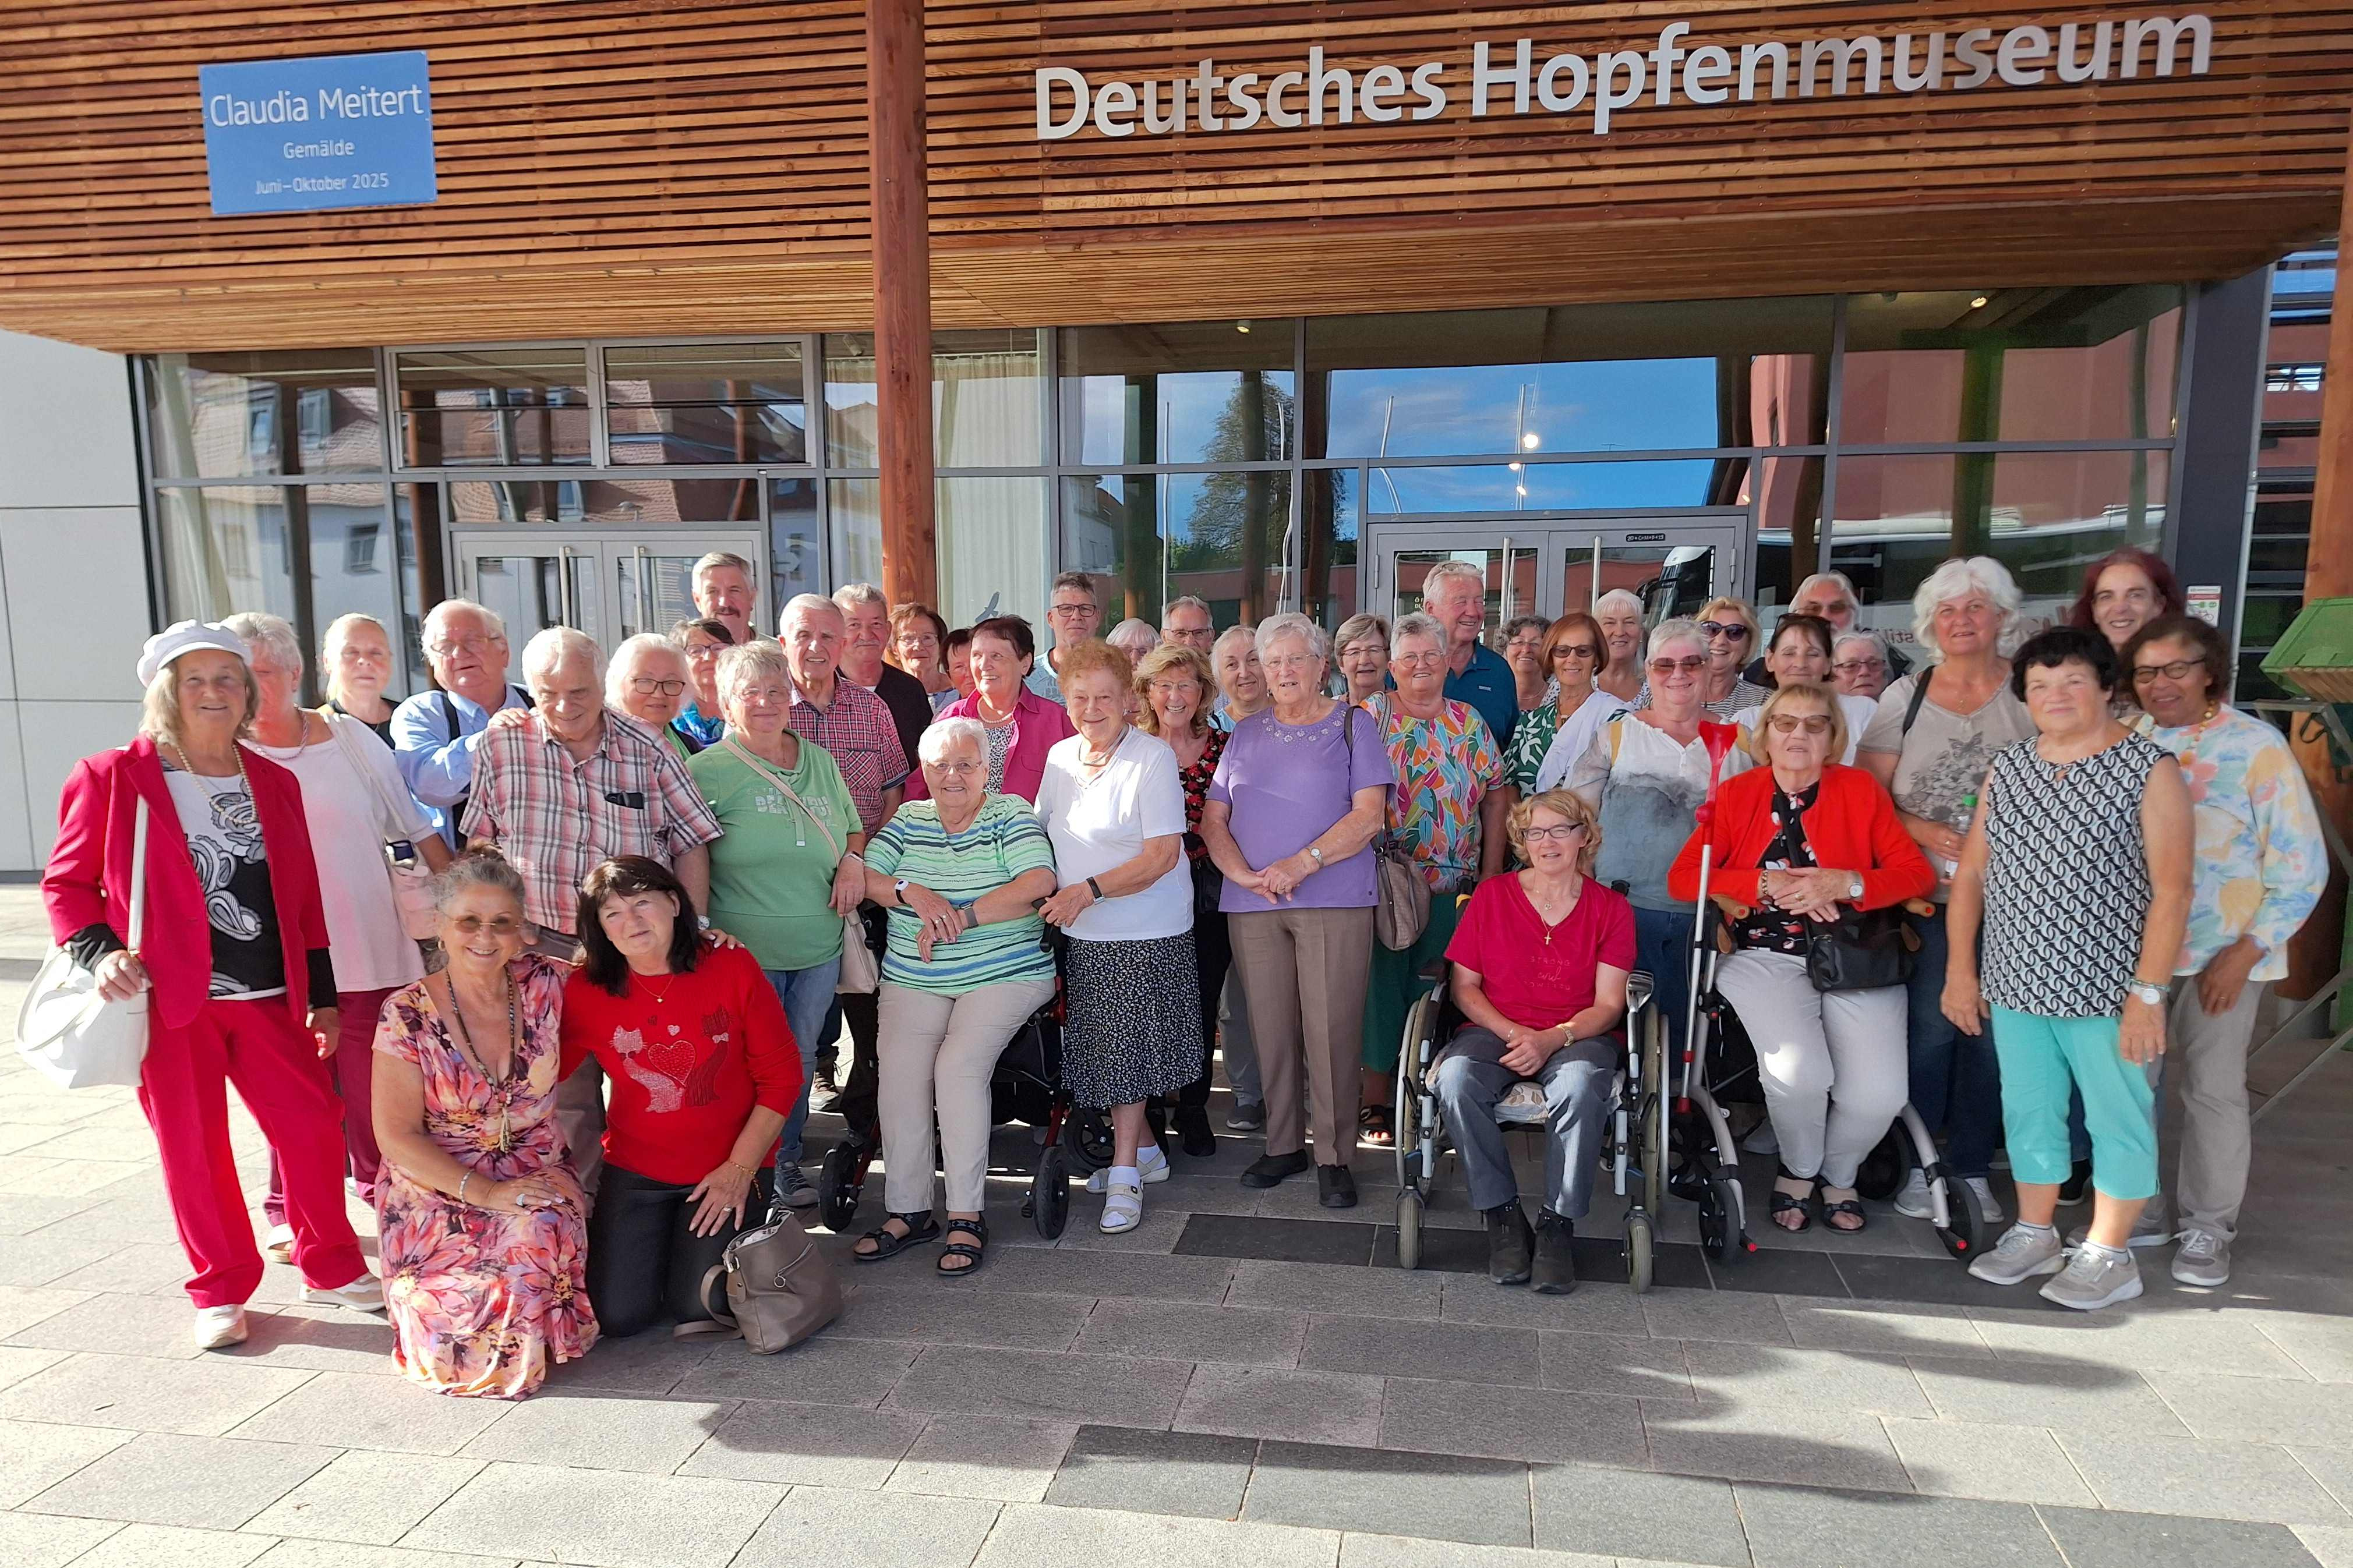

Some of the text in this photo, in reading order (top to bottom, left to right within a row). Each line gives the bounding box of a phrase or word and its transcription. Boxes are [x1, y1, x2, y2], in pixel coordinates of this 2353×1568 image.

[1034, 13, 2212, 140] Deutsches Hopfenmuseum
[210, 84, 425, 127] Claudia Meitert
[284, 139, 355, 159] Gemälde
[351, 172, 390, 189] 2025
